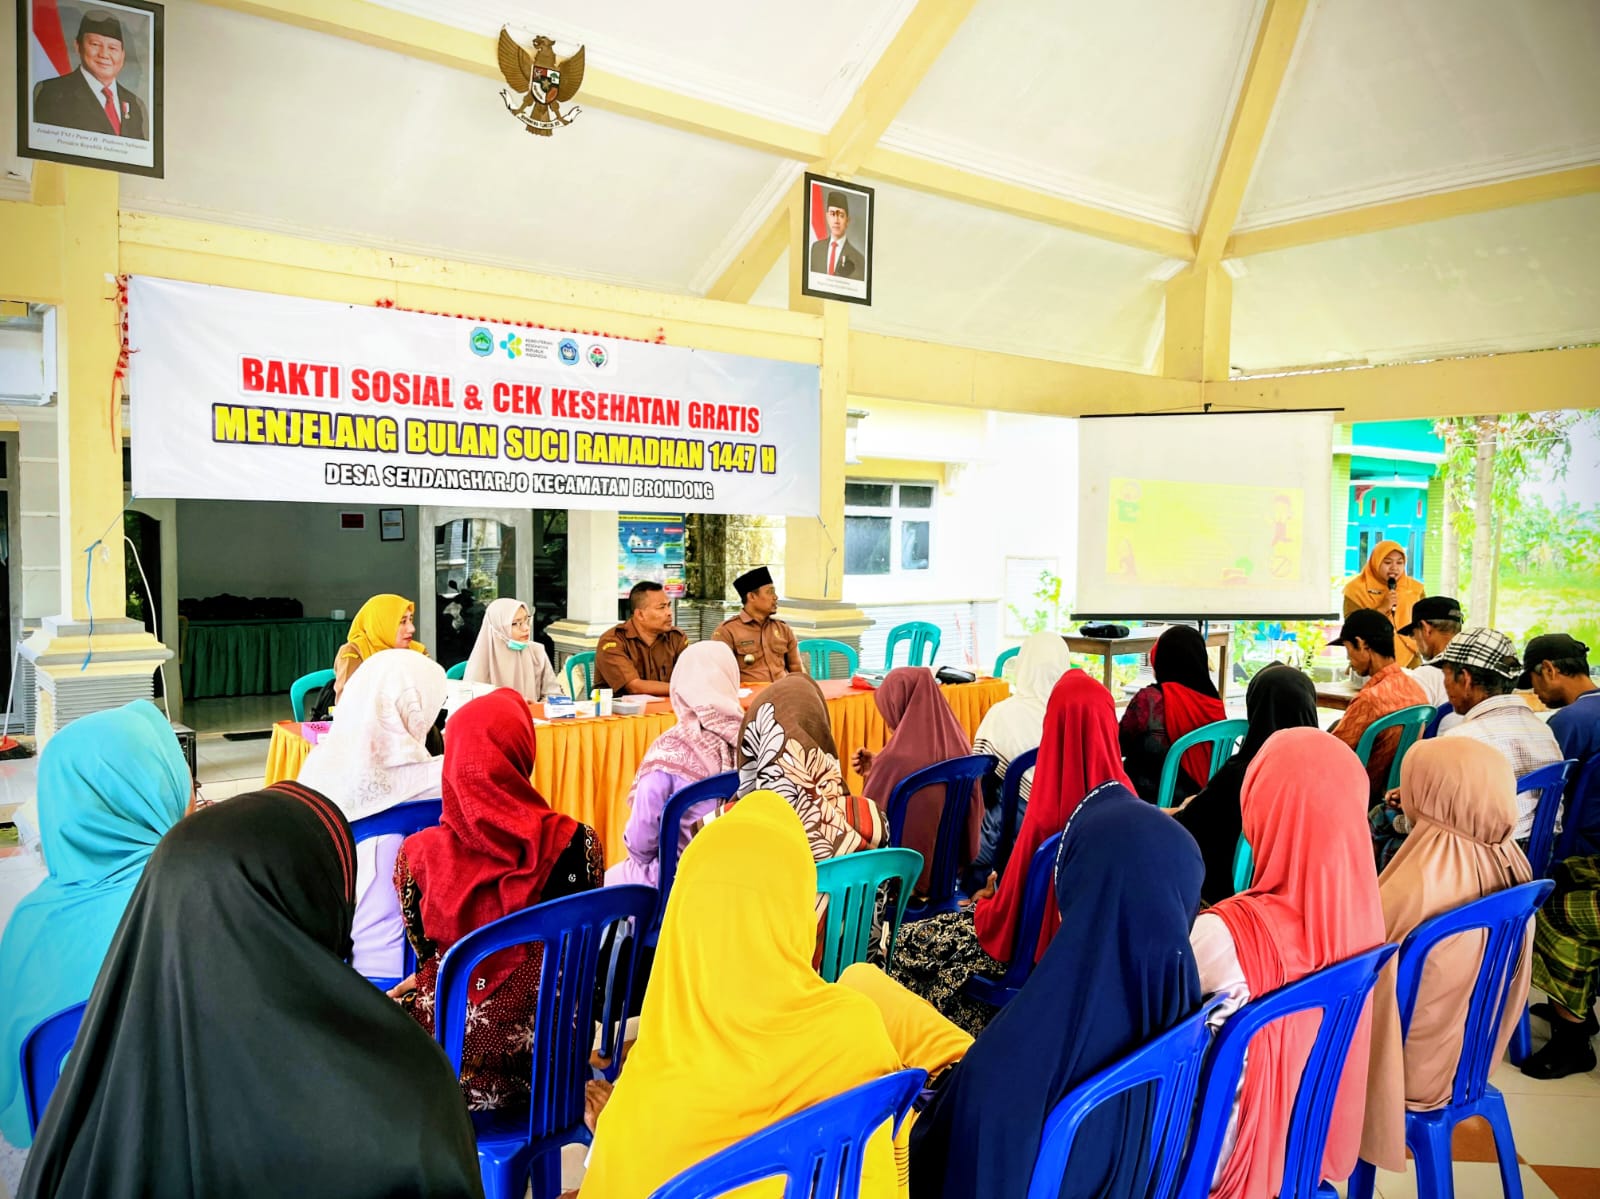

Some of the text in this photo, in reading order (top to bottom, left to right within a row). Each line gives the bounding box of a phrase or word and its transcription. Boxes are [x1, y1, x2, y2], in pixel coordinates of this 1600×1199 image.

[242, 357, 760, 434] BAKTI SOSIAL & CEK KESEHATAN GRATIS
[212, 403, 776, 474] MENJELANG BULAN SUCI RAMADHAN 1447 H
[325, 463, 714, 500] DESA SENDANGHARJO KECAMATAN BRONDONG
